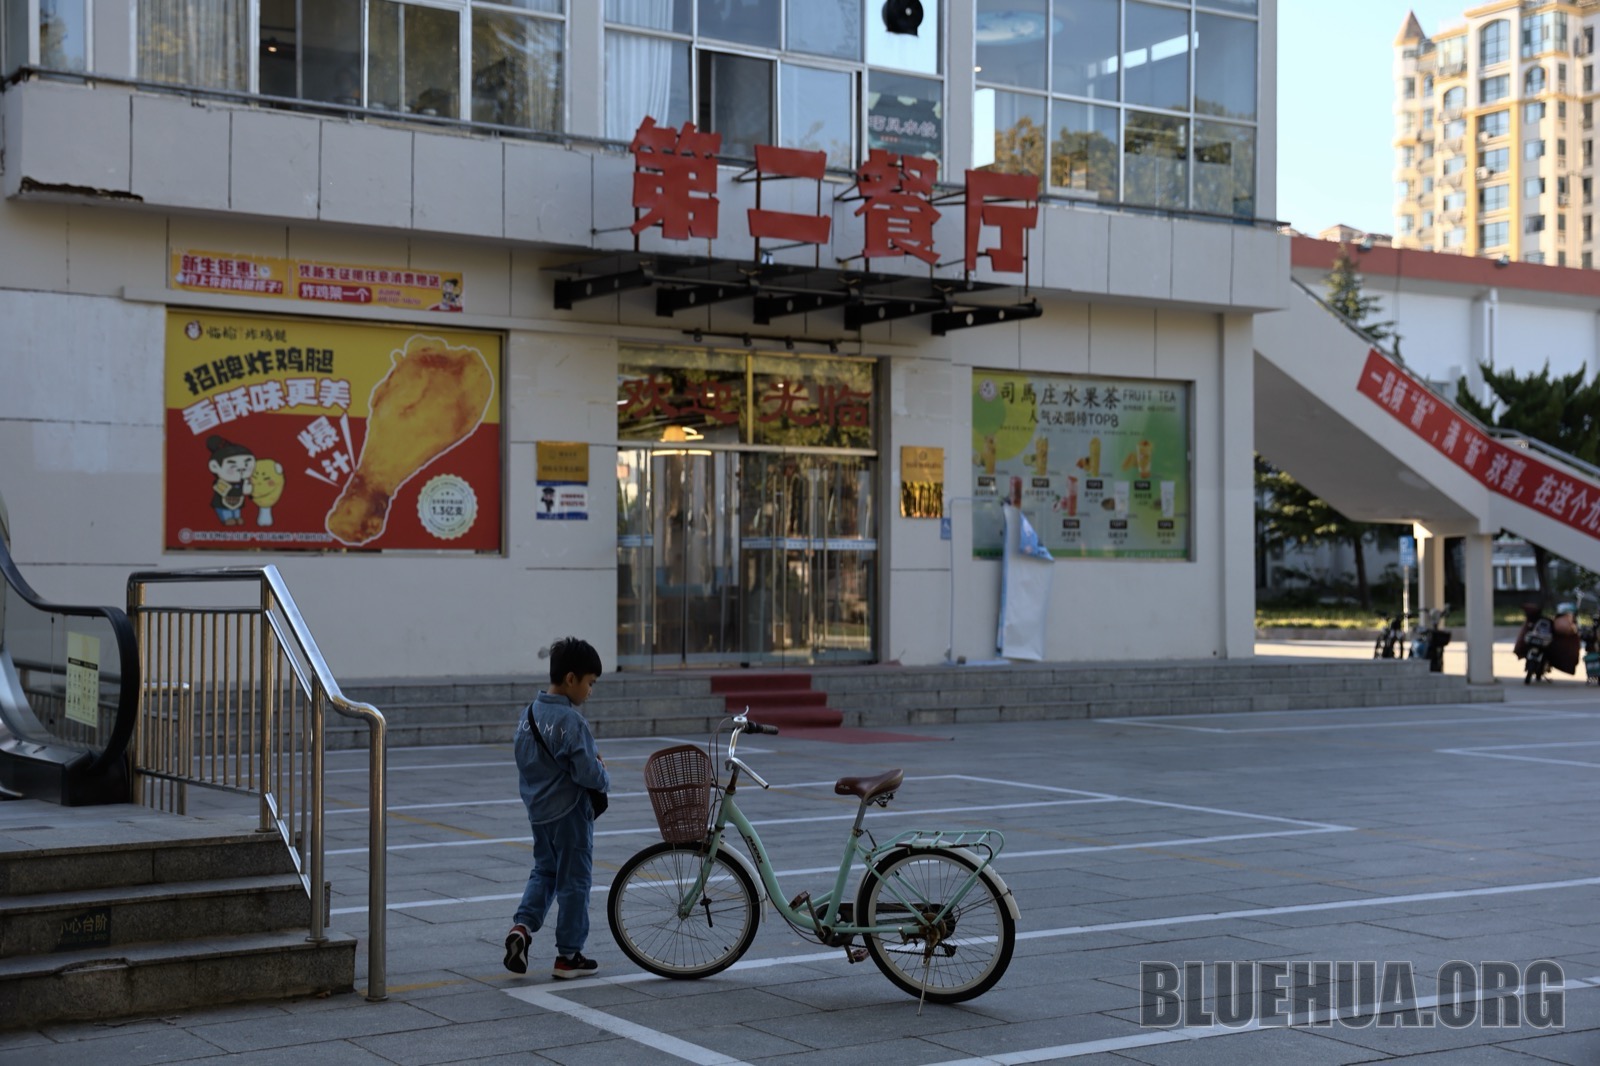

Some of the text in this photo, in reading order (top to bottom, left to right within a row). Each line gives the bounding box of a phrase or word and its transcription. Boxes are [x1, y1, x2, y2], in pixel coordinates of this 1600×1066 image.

[629, 115, 1038, 273] 第二餐厅
[184, 347, 334, 396] 招牌炸鸡腿
[1159, 391, 1176, 402] TEA
[182, 378, 350, 435] 香酥味更美
[617, 375, 871, 427] 欢迎光临
[297, 416, 350, 481] 爆汁
[432, 506, 464, 516] 1.3亿支
